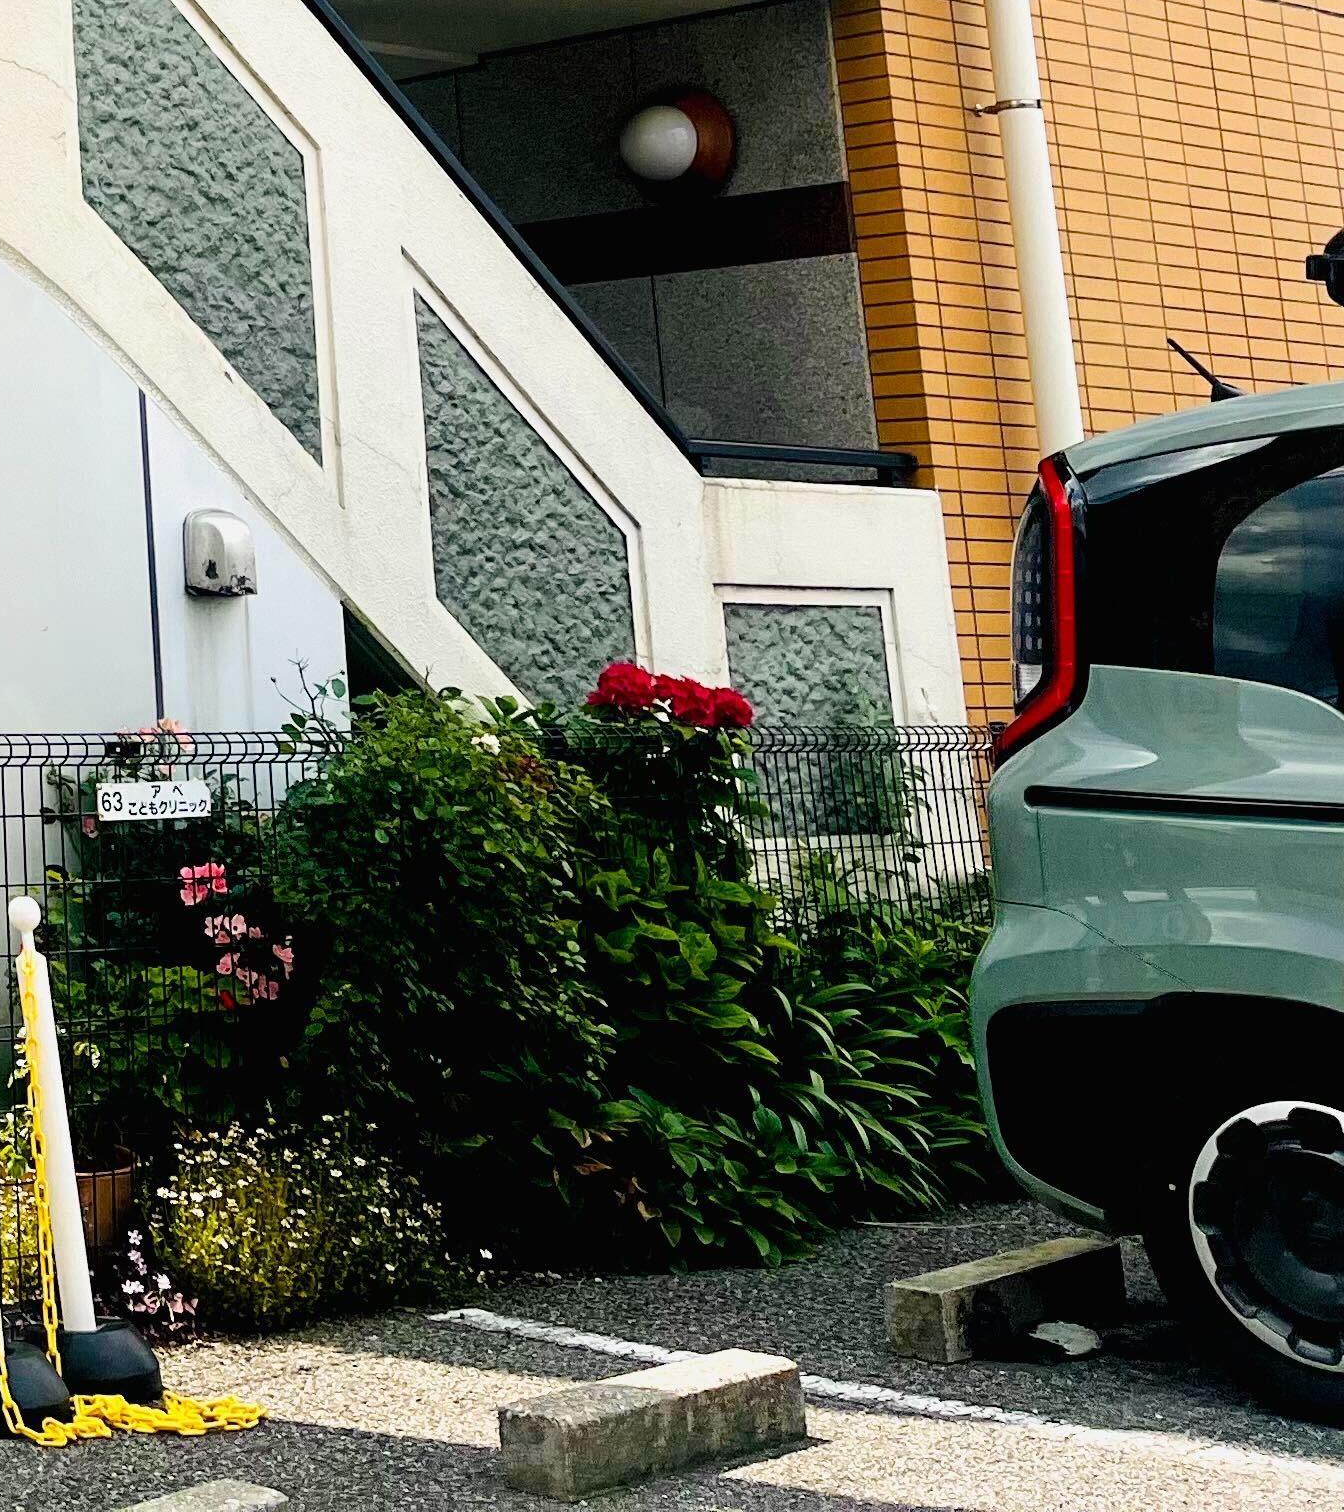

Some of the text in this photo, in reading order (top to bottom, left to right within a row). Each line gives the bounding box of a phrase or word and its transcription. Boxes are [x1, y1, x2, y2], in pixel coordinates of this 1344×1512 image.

[101, 791, 123, 813] 63
[128, 799, 208, 816] こどもクリニック
